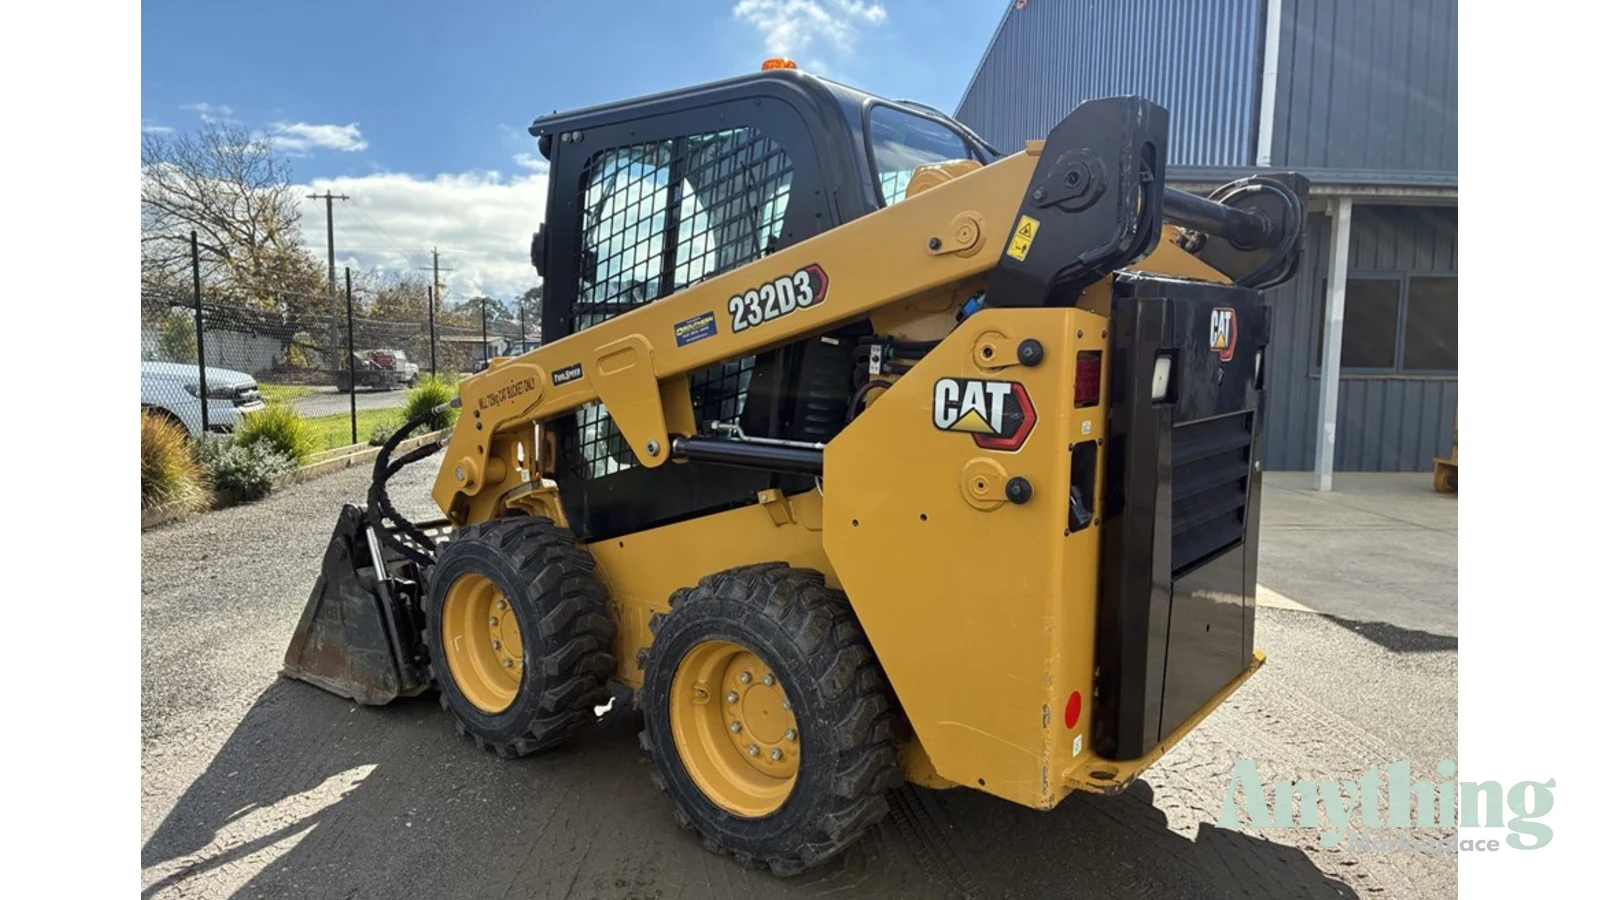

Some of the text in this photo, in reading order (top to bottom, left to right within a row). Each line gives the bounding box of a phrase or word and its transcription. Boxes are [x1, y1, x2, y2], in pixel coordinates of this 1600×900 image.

[729, 270, 814, 332] 232D3
[1210, 310, 1232, 348] CAT
[934, 379, 1012, 434] CAT
